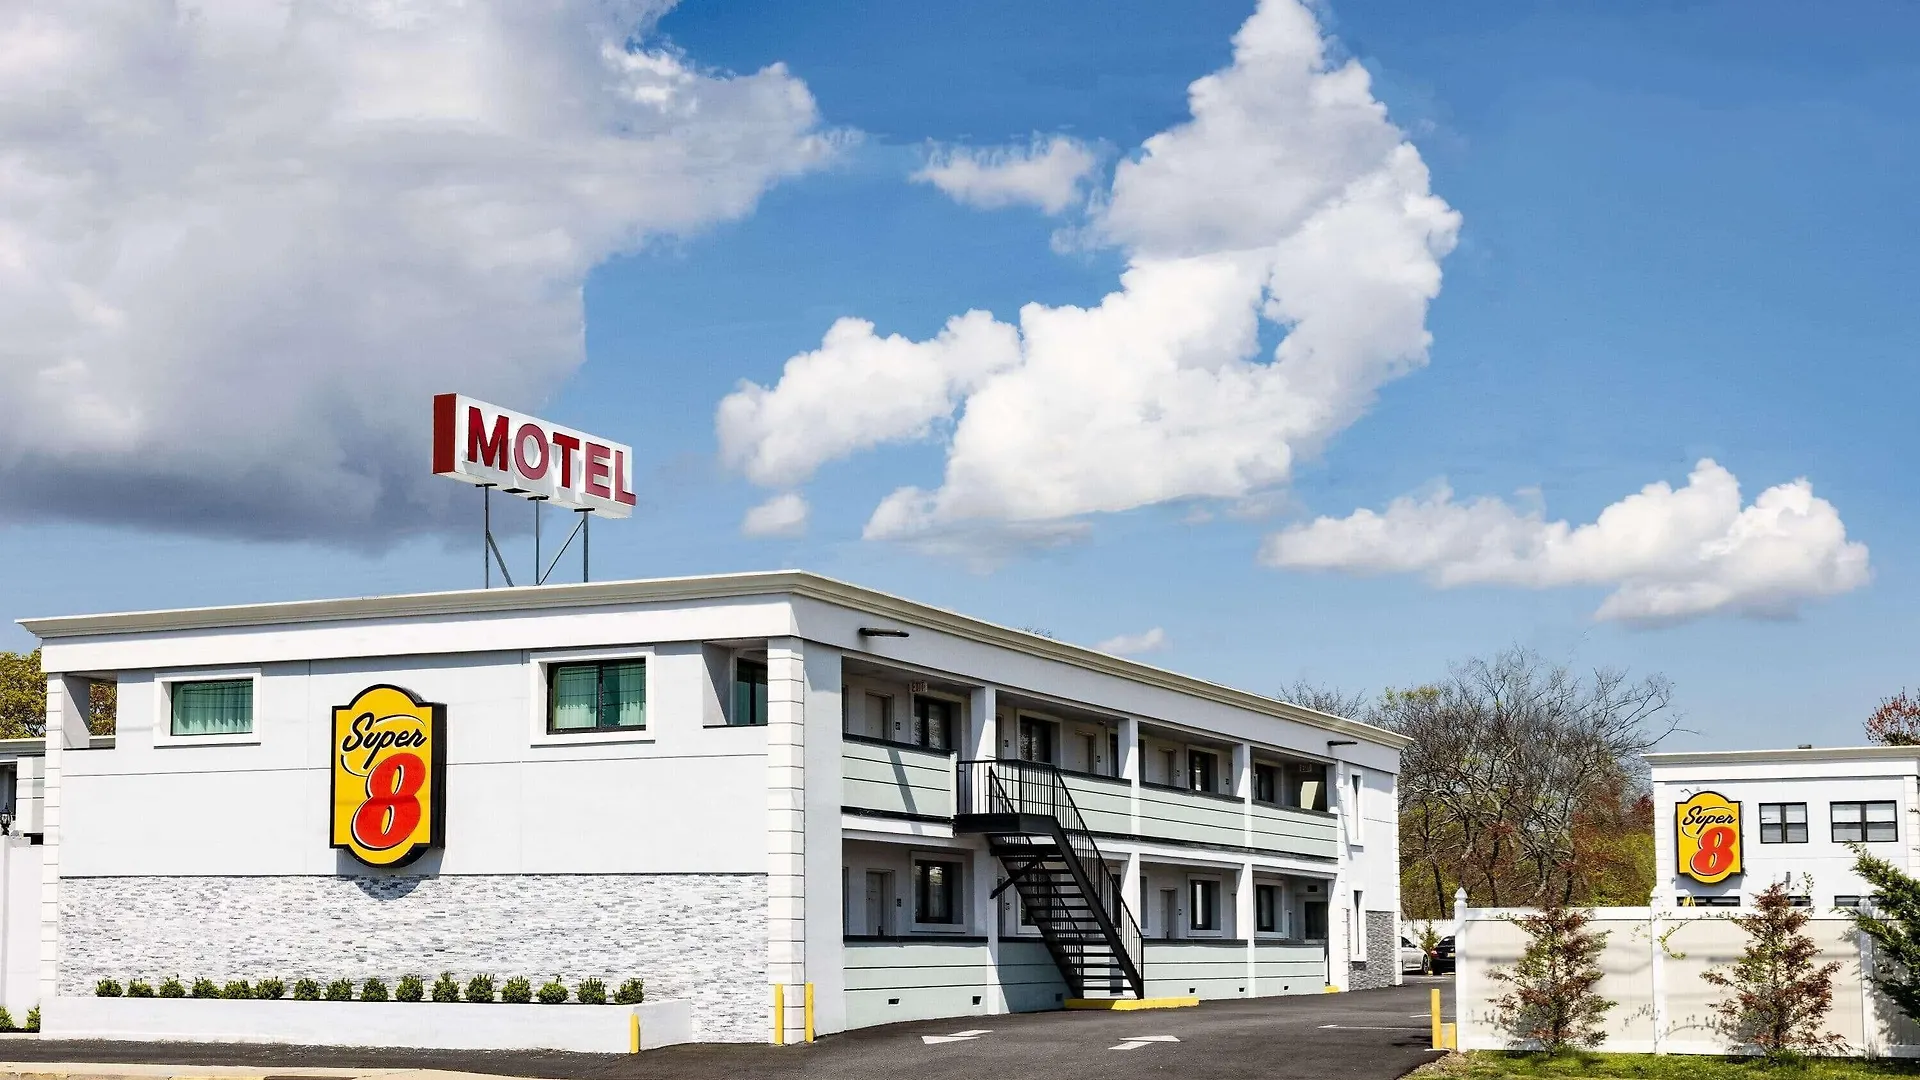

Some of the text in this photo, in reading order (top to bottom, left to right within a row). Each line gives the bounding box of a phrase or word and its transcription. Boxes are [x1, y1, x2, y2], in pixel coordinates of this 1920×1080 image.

[467, 406, 636, 506] MOTEL
[342, 712, 427, 769] Super
[351, 753, 426, 851] 8
[1682, 806, 1736, 834] Super
[1690, 827, 1736, 876] 8
